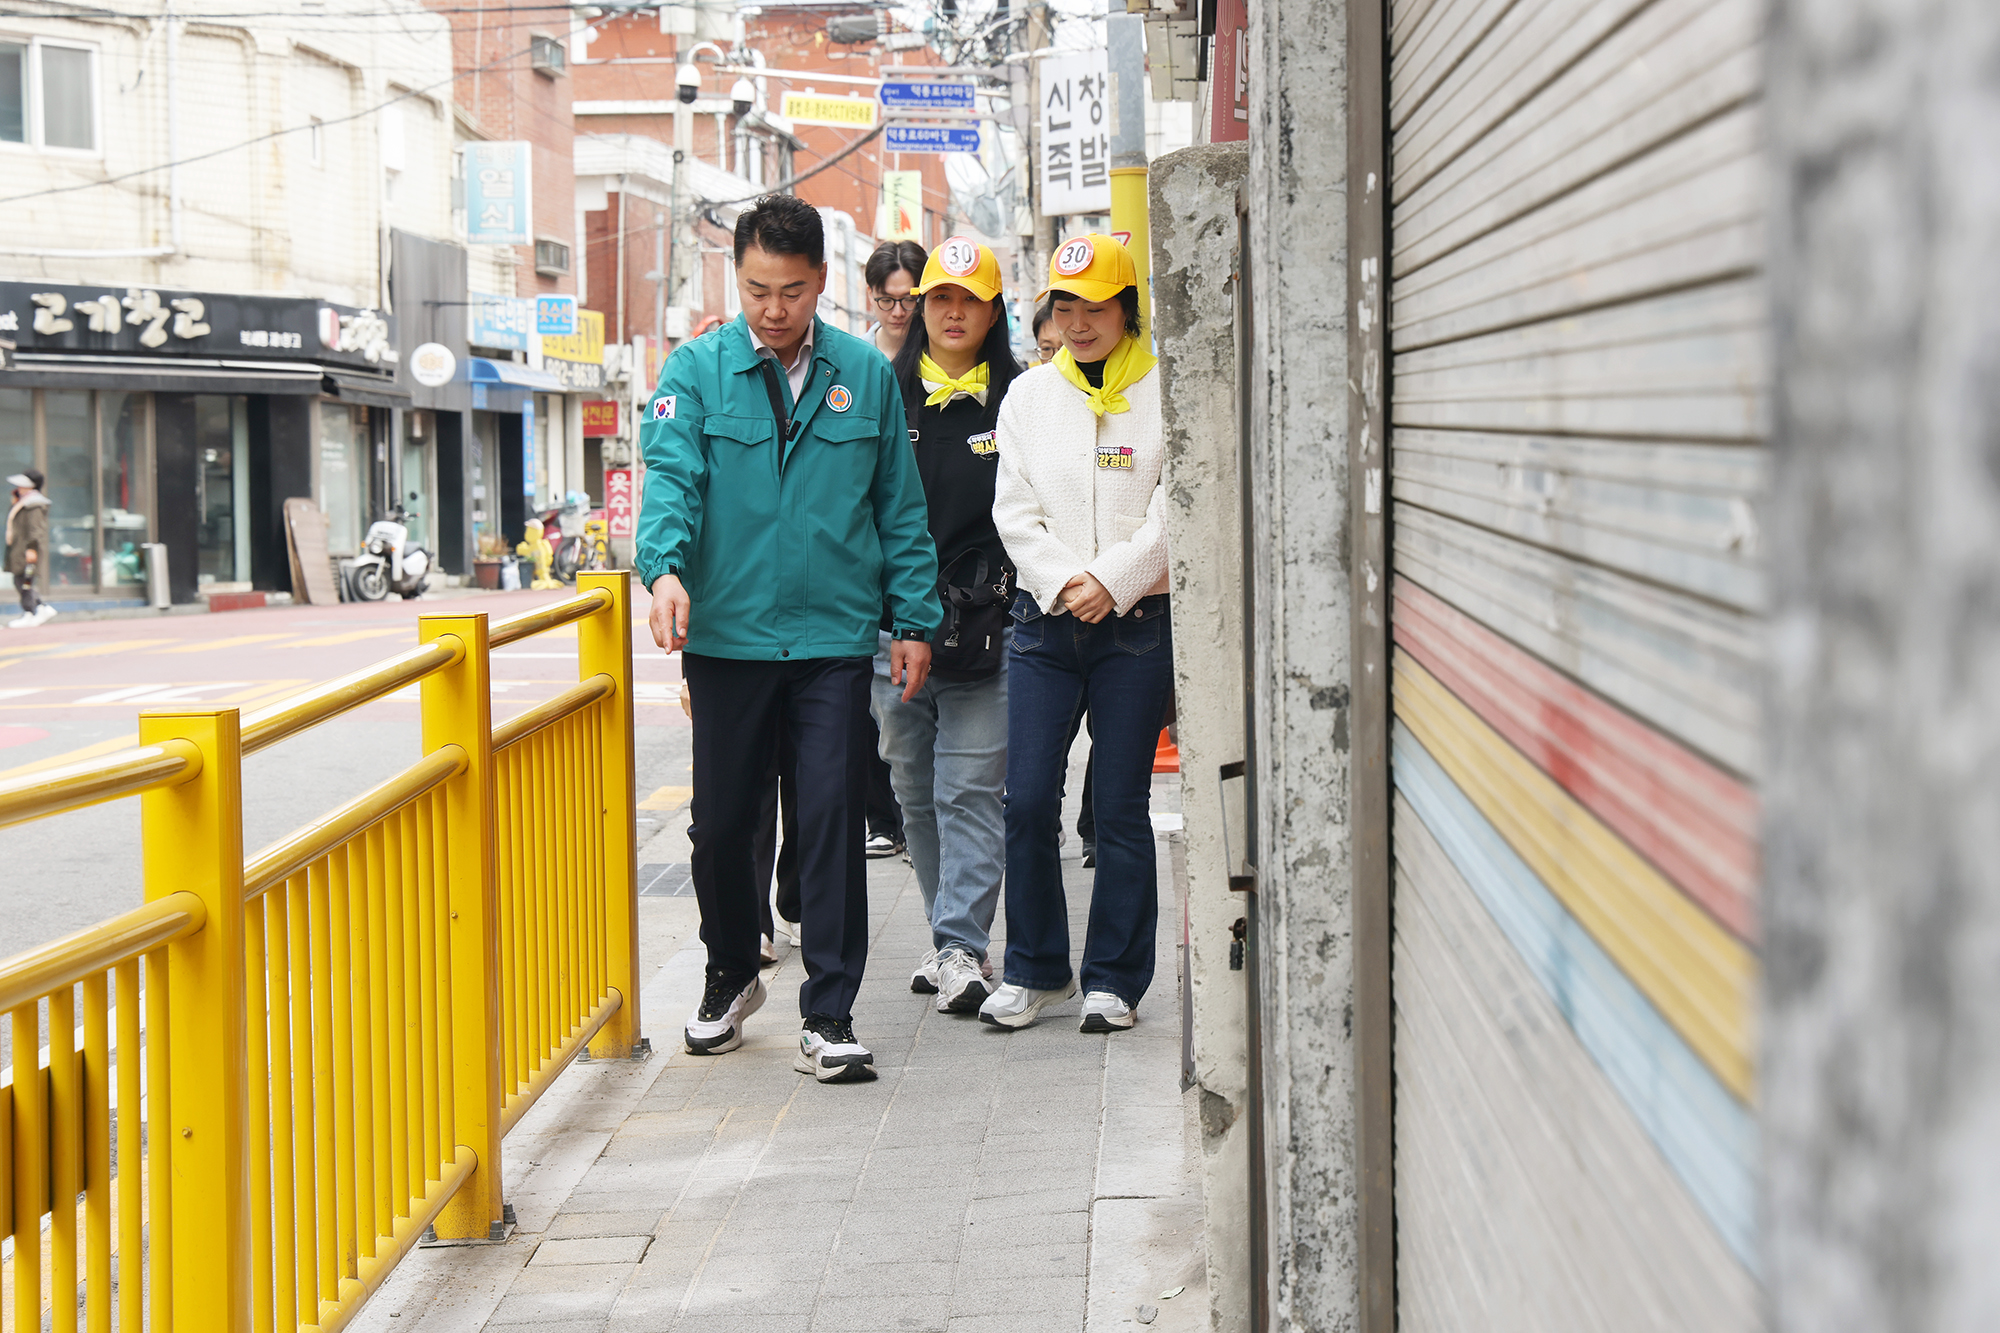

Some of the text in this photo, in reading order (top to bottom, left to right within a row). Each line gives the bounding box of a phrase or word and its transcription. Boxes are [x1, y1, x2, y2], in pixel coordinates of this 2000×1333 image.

[1047, 72, 1106, 132] 신창
[1047, 133, 1108, 190] 족발
[478, 167, 515, 233] 열쇠
[948, 243, 973, 265] 30
[1062, 245, 1087, 264] 30
[31, 286, 212, 348] 고기창고
[538, 300, 572, 323] 옷수선
[608, 472, 632, 536] 옷수선
